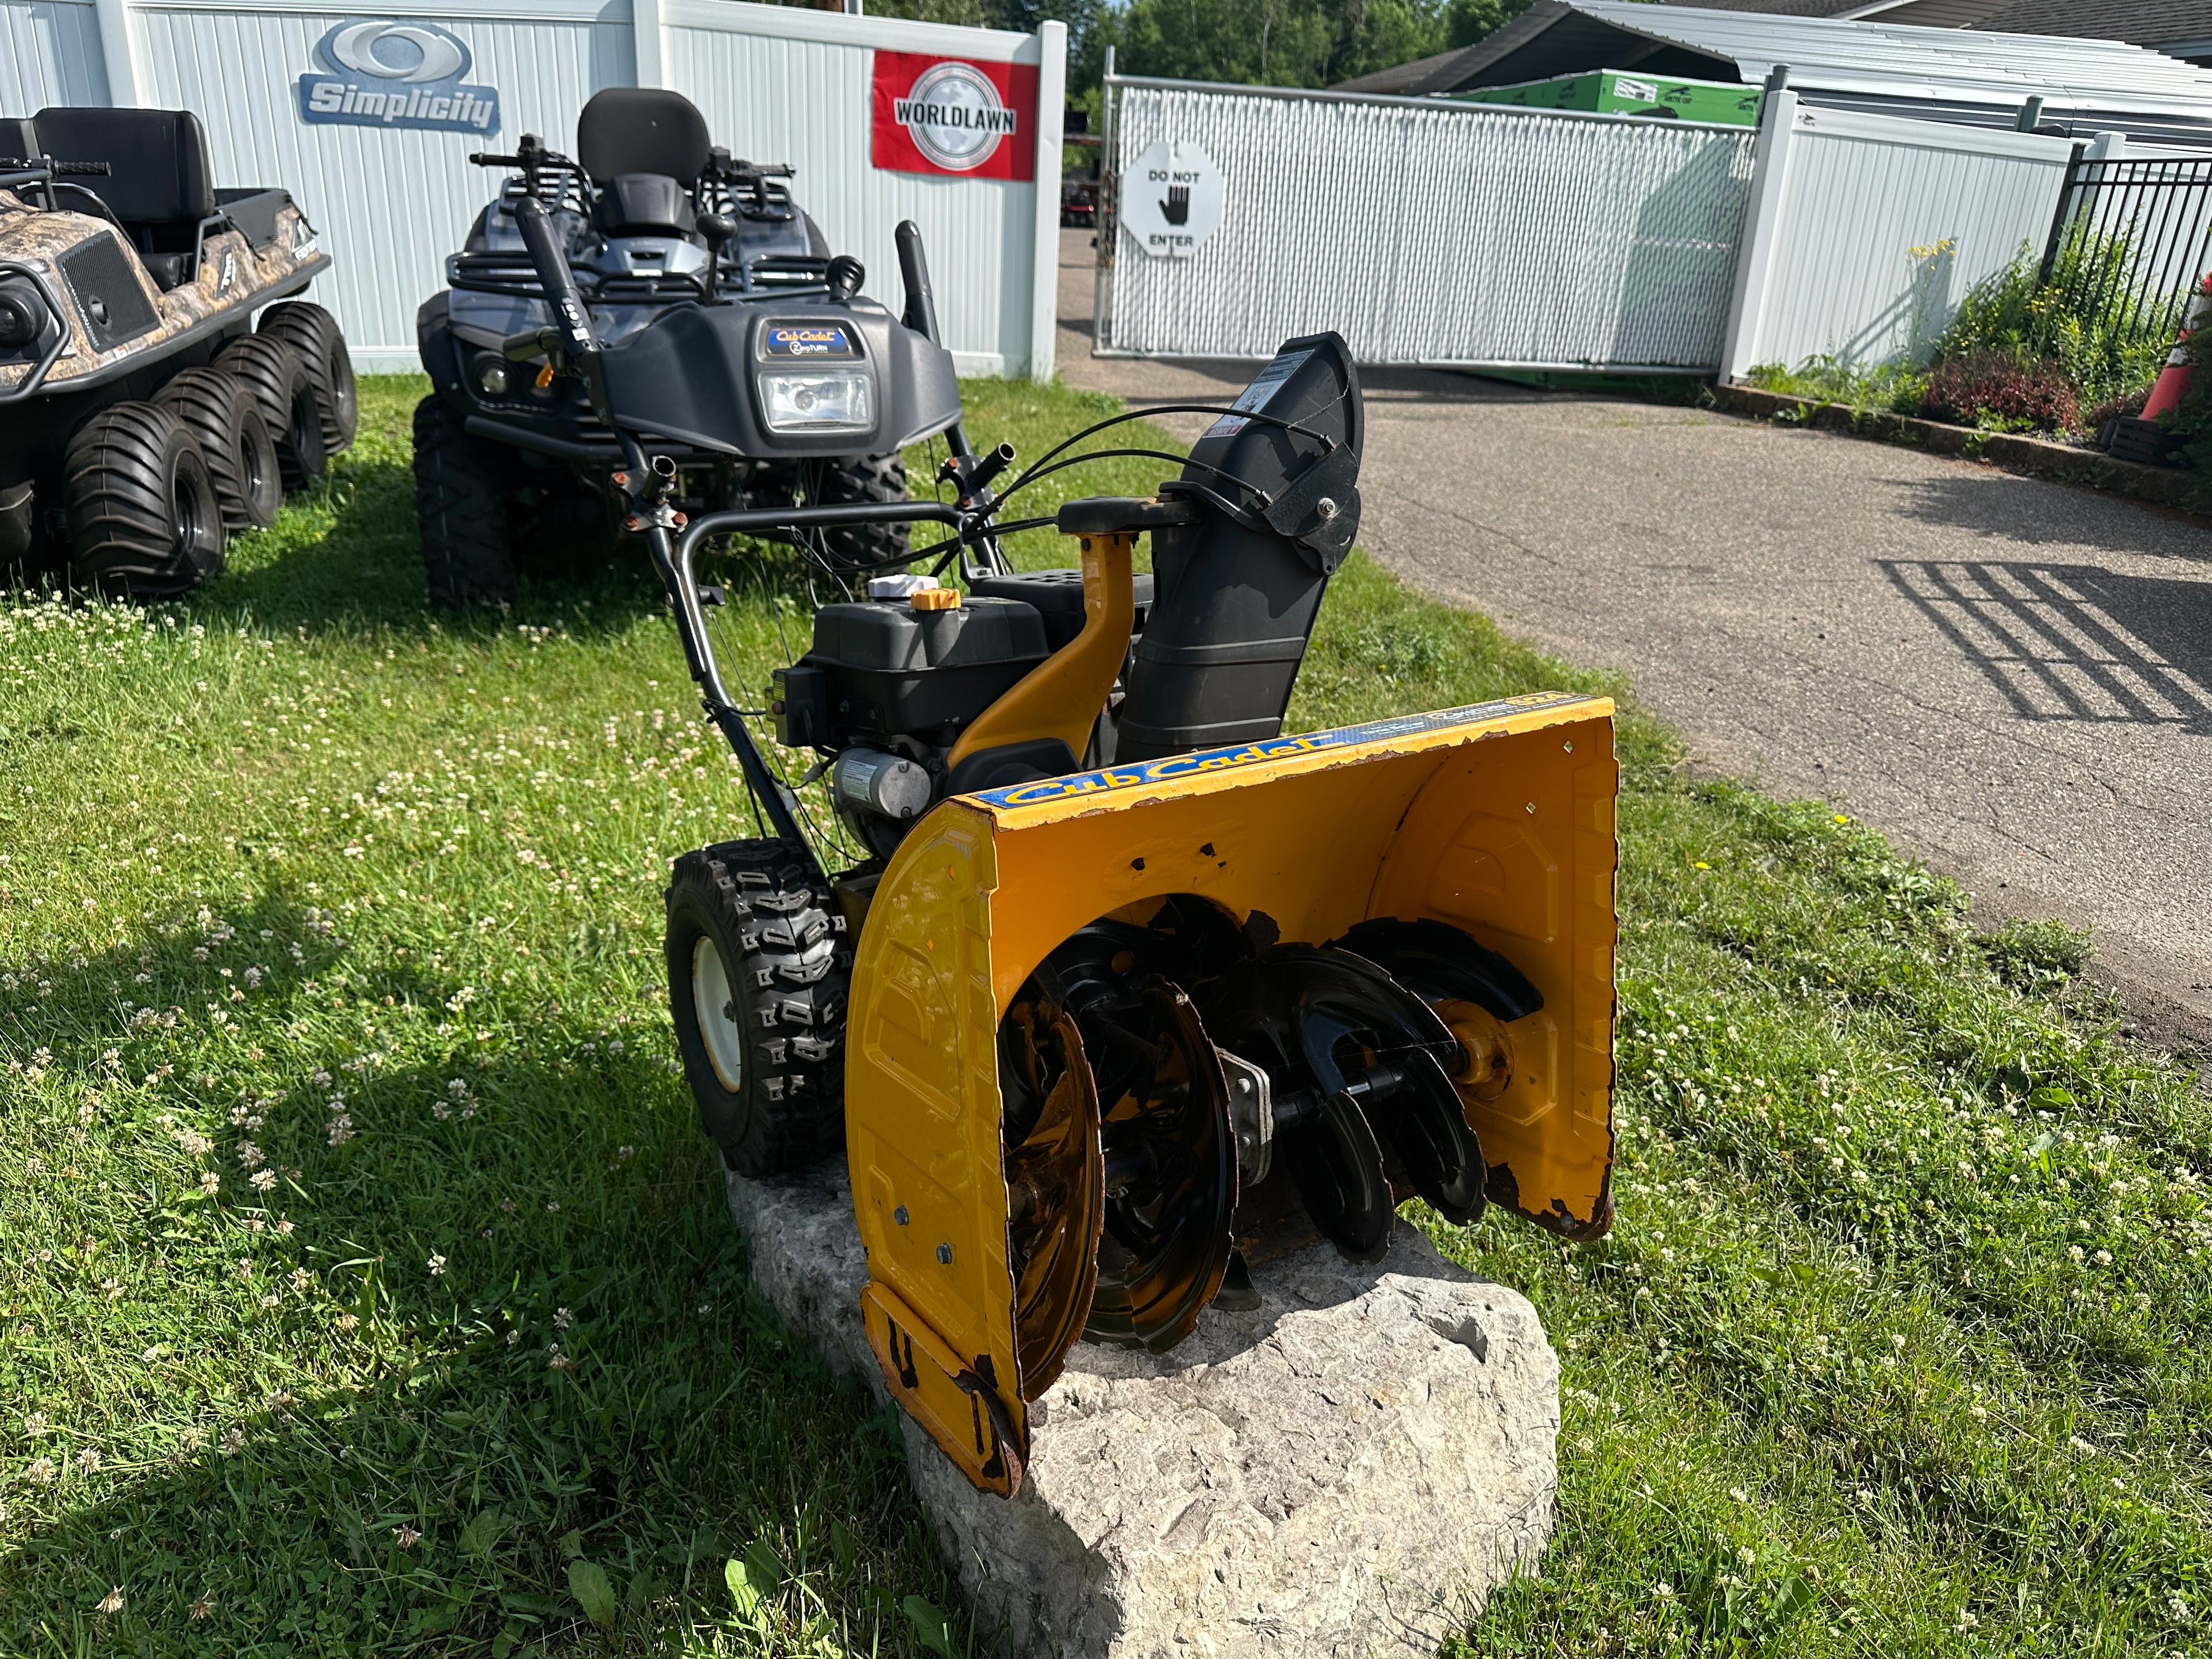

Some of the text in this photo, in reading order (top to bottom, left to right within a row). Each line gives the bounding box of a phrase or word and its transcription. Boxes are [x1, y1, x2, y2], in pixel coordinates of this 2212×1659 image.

[308, 82, 494, 129] Simplicity
[896, 101, 1014, 132] WORLDLAWN
[1149, 171, 1200, 184] DO NOT
[1149, 235, 1192, 247] ENTER
[776, 331, 835, 342] Cub Cadet
[1005, 734, 1345, 804] Cub Cadet
